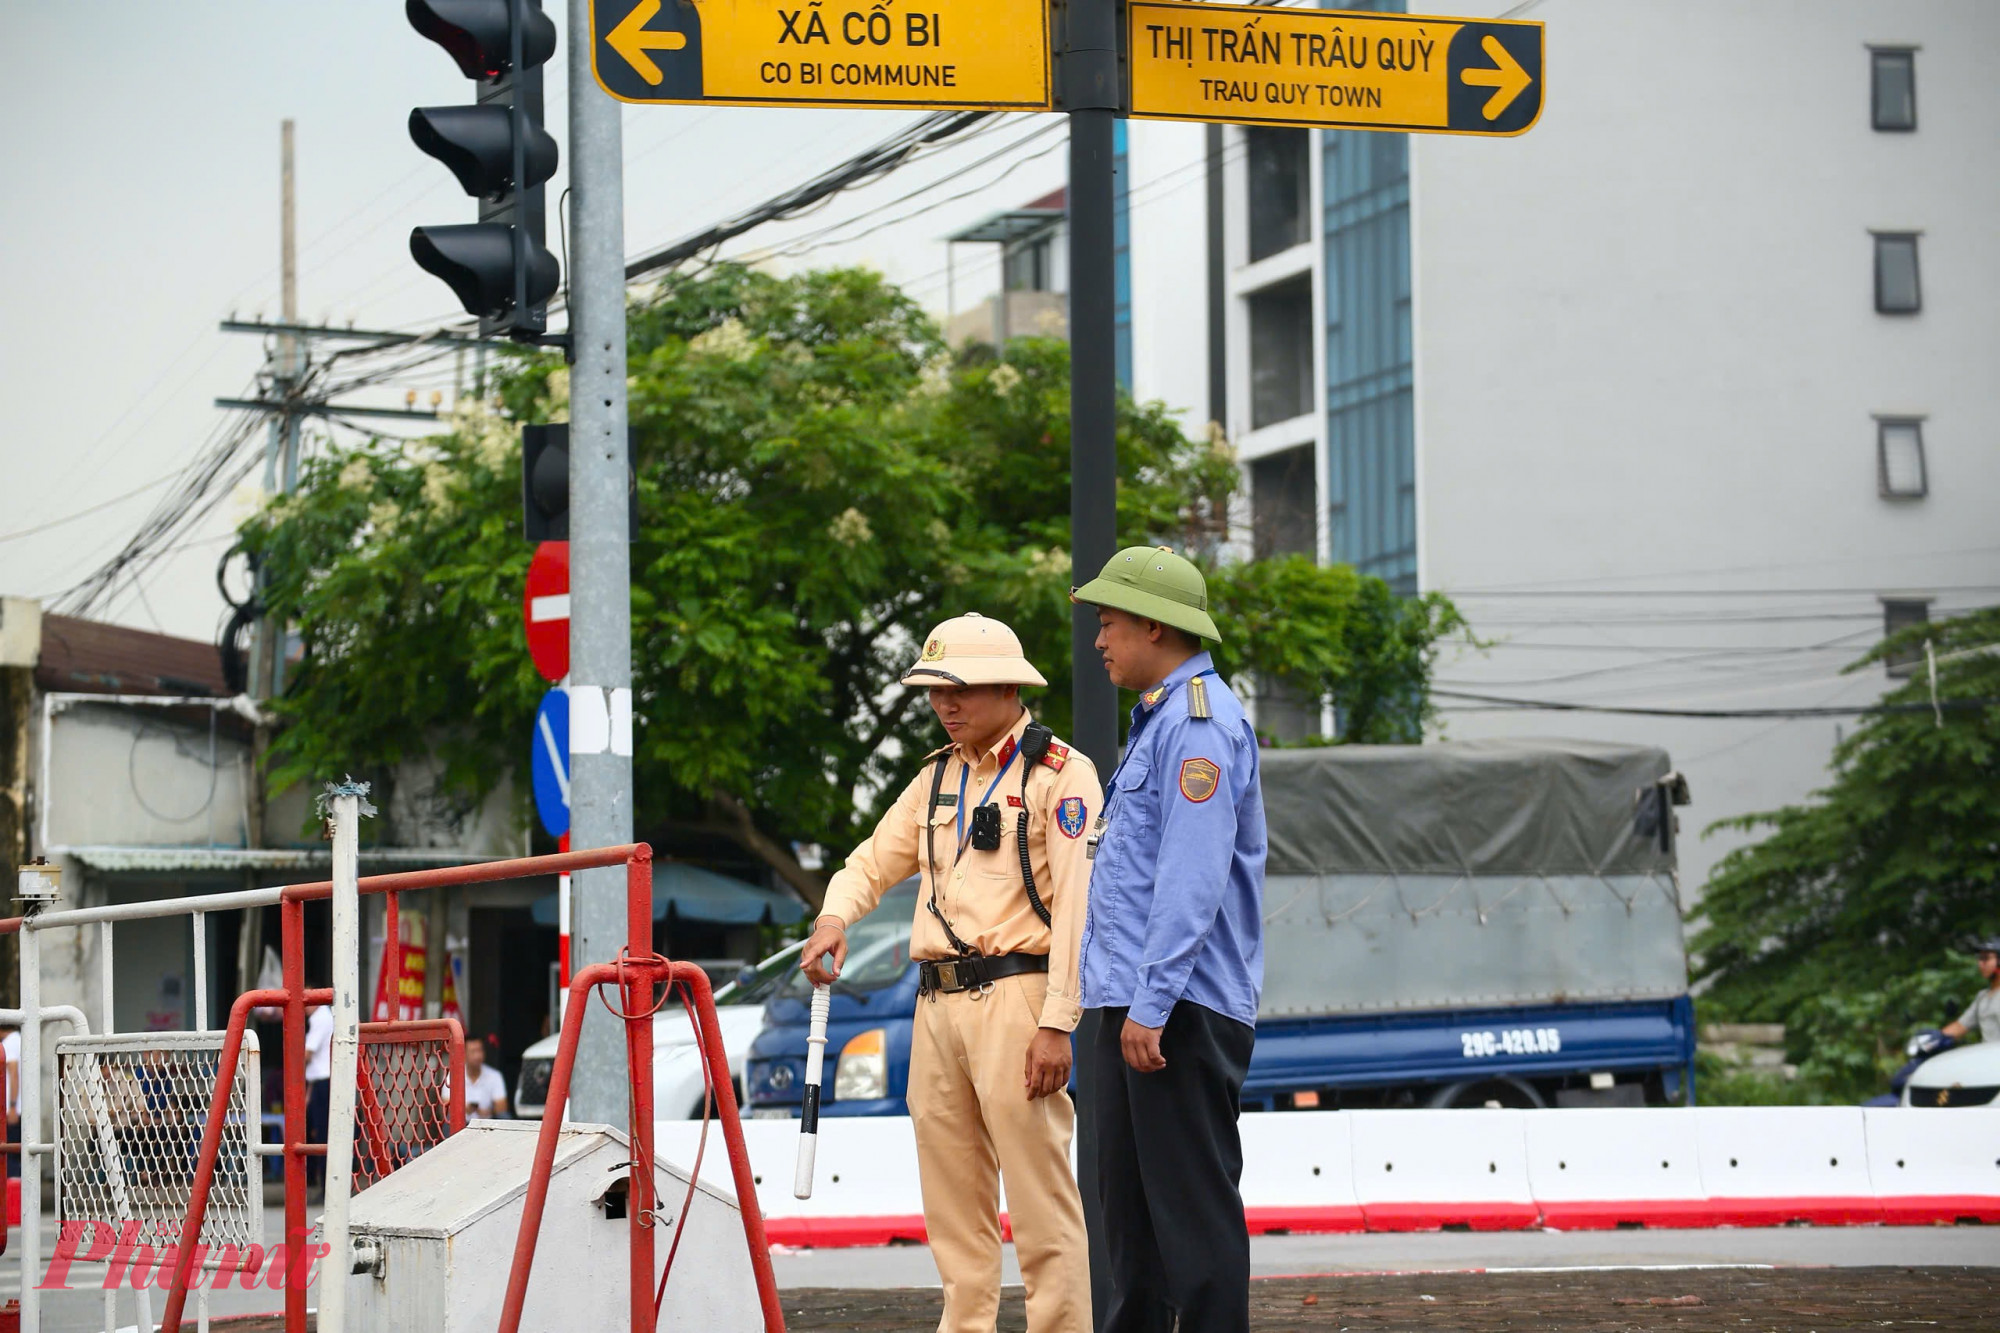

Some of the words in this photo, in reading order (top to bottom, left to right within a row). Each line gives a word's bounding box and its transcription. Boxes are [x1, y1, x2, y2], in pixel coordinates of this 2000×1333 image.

[778, 1, 830, 44] XÃ
[906, 12, 940, 47] BI
[1146, 24, 1192, 68] THỊ
[1201, 16, 1281, 65] TRẤN
[1289, 26, 1367, 69] TRÂU
[1377, 28, 1434, 72] QUỲ
[760, 61, 791, 84] CO
[800, 62, 822, 85] BI
[830, 63, 956, 87] COMMUNE
[1200, 79, 1258, 102] TRAU
[1265, 82, 1310, 105] QUY
[1315, 84, 1381, 108] TOWN
